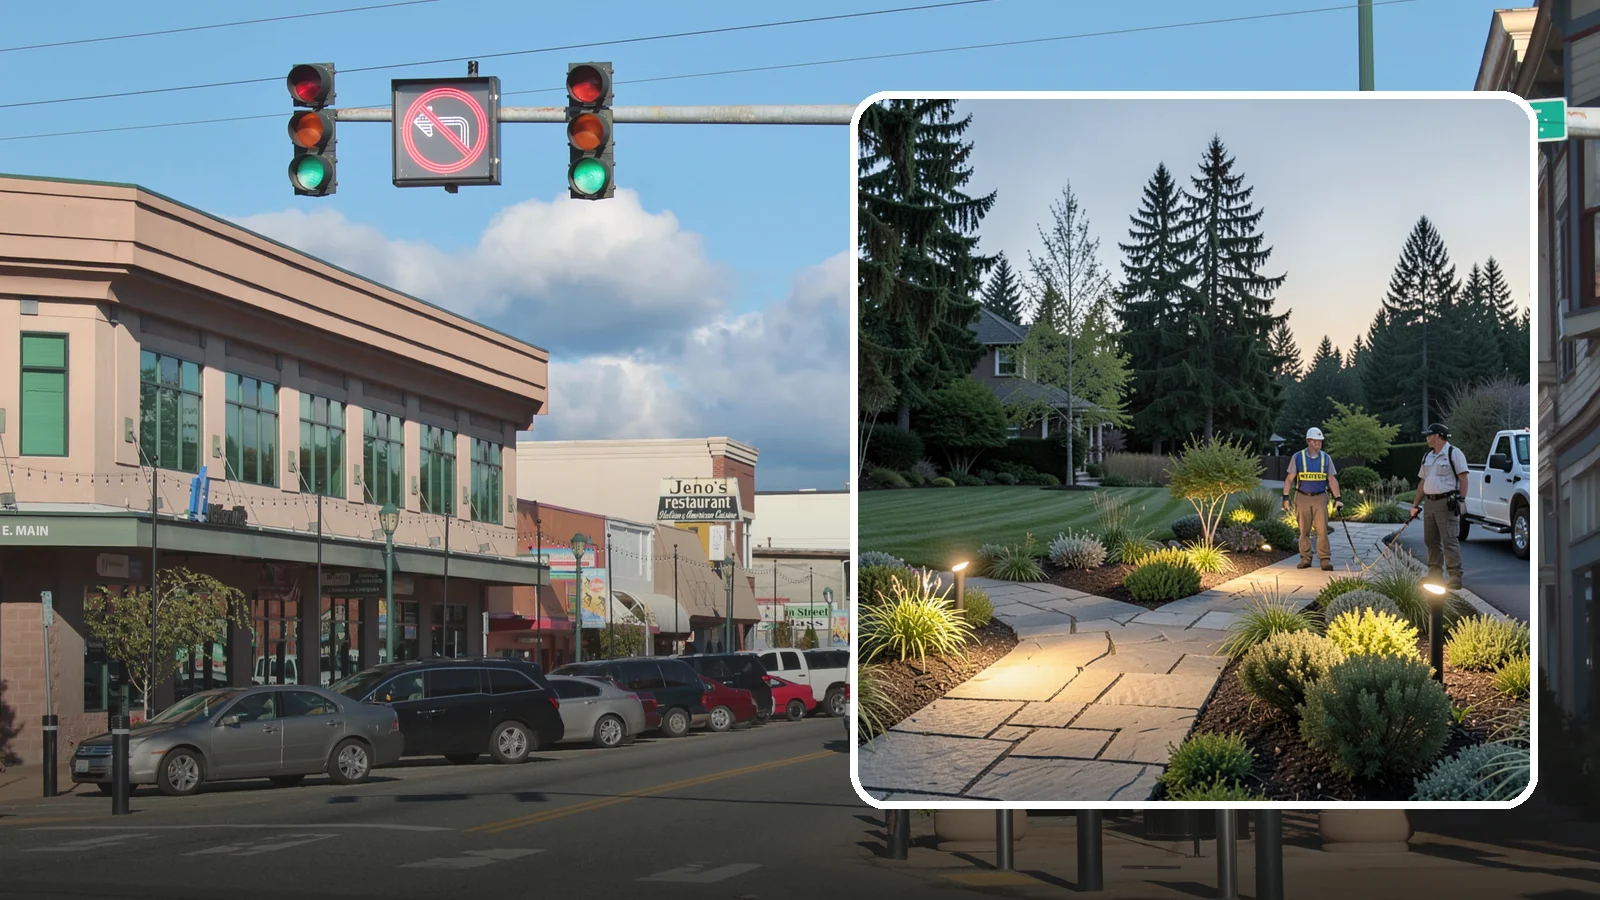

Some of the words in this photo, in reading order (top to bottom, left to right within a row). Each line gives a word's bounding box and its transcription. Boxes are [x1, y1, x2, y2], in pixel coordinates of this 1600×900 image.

[670, 480, 728, 494] Jeno's
[665, 496, 731, 509] restaurant
[686, 509, 714, 519] American
[715, 509, 737, 519] Cuisine
[2, 525, 13, 536] E.
[15, 525, 49, 536] MAIN
[797, 607, 829, 617] Street
